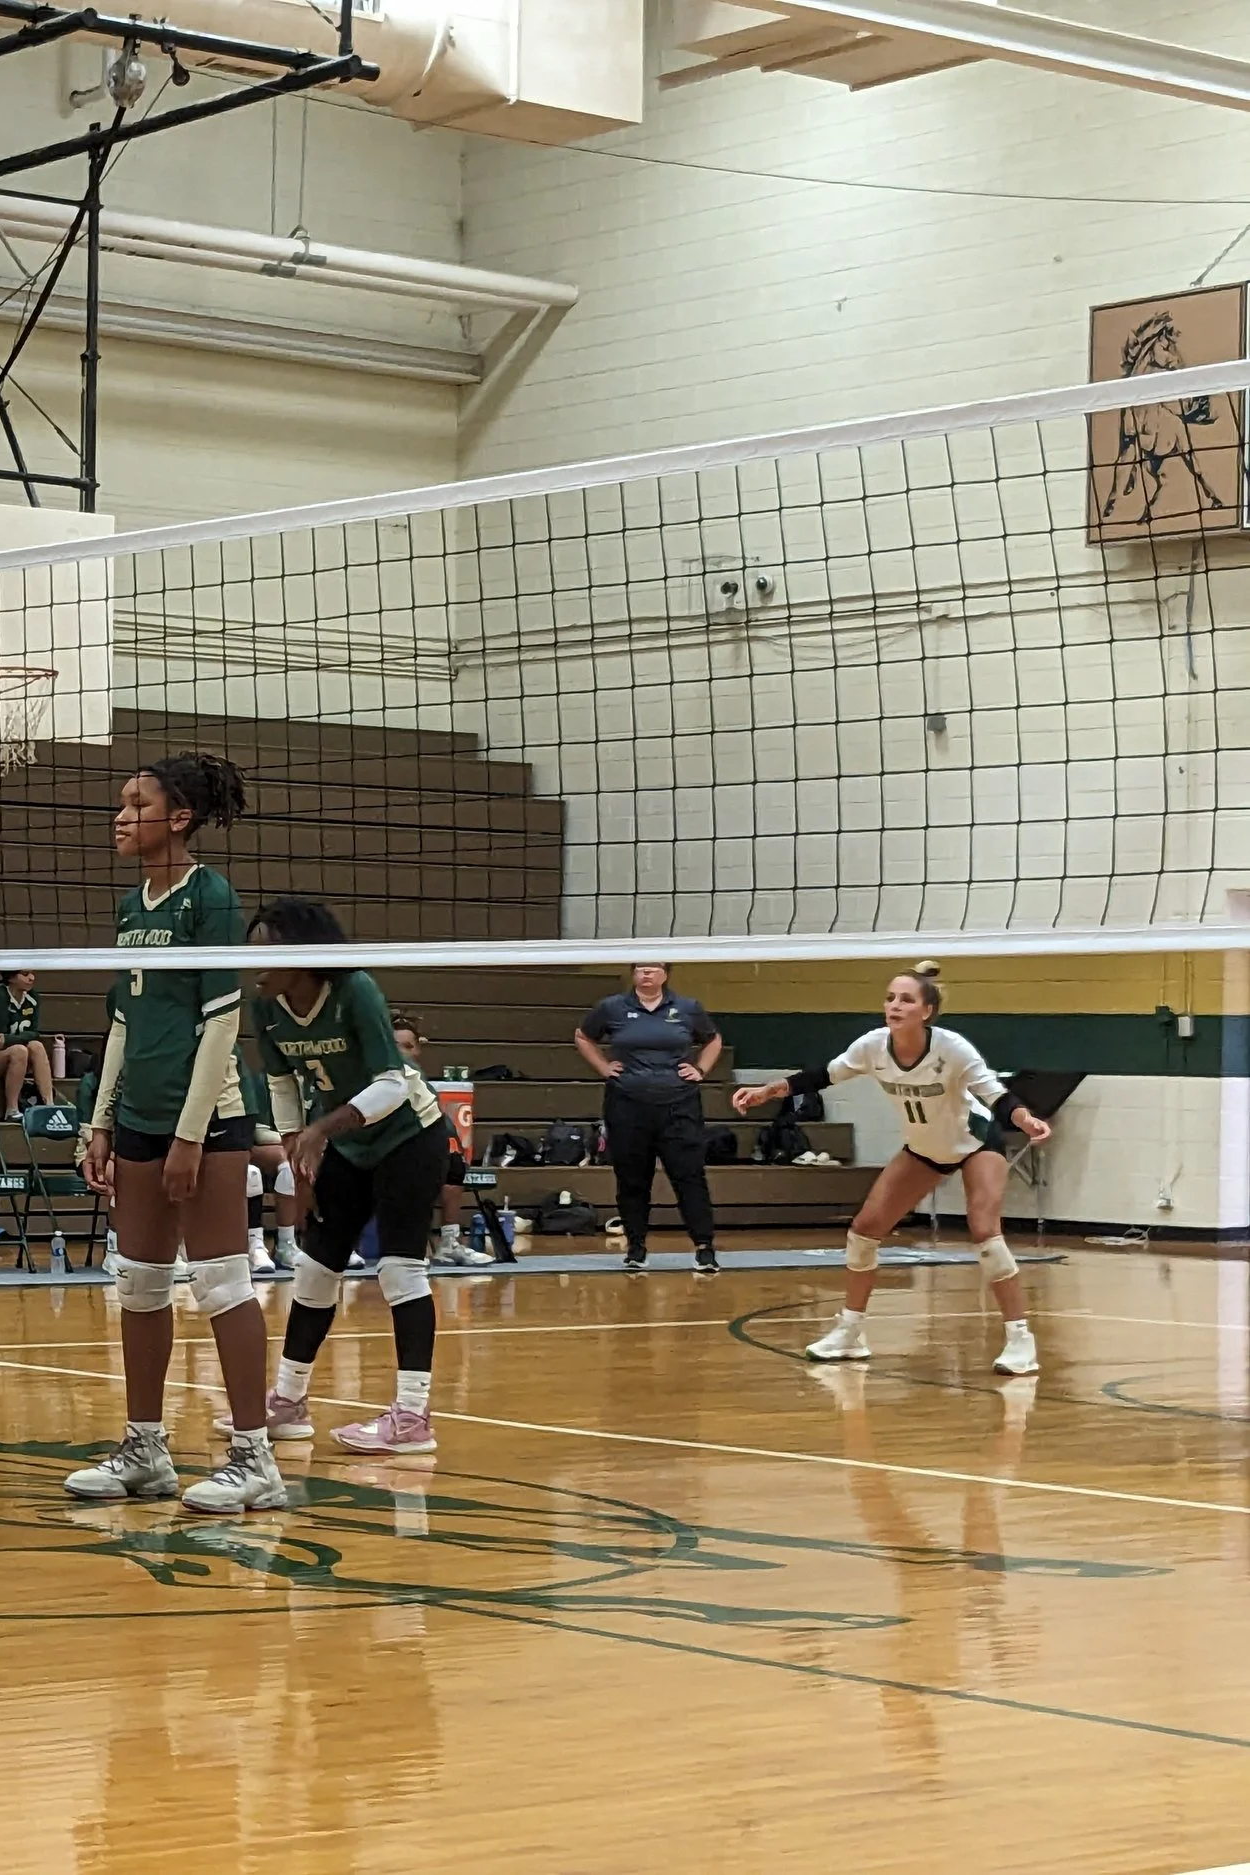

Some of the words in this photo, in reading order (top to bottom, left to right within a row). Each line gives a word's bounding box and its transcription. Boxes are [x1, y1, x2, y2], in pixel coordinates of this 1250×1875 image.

[305, 1060, 334, 1091] 3
[458, 1105, 472, 1127] G
[904, 1100, 928, 1124] 11
